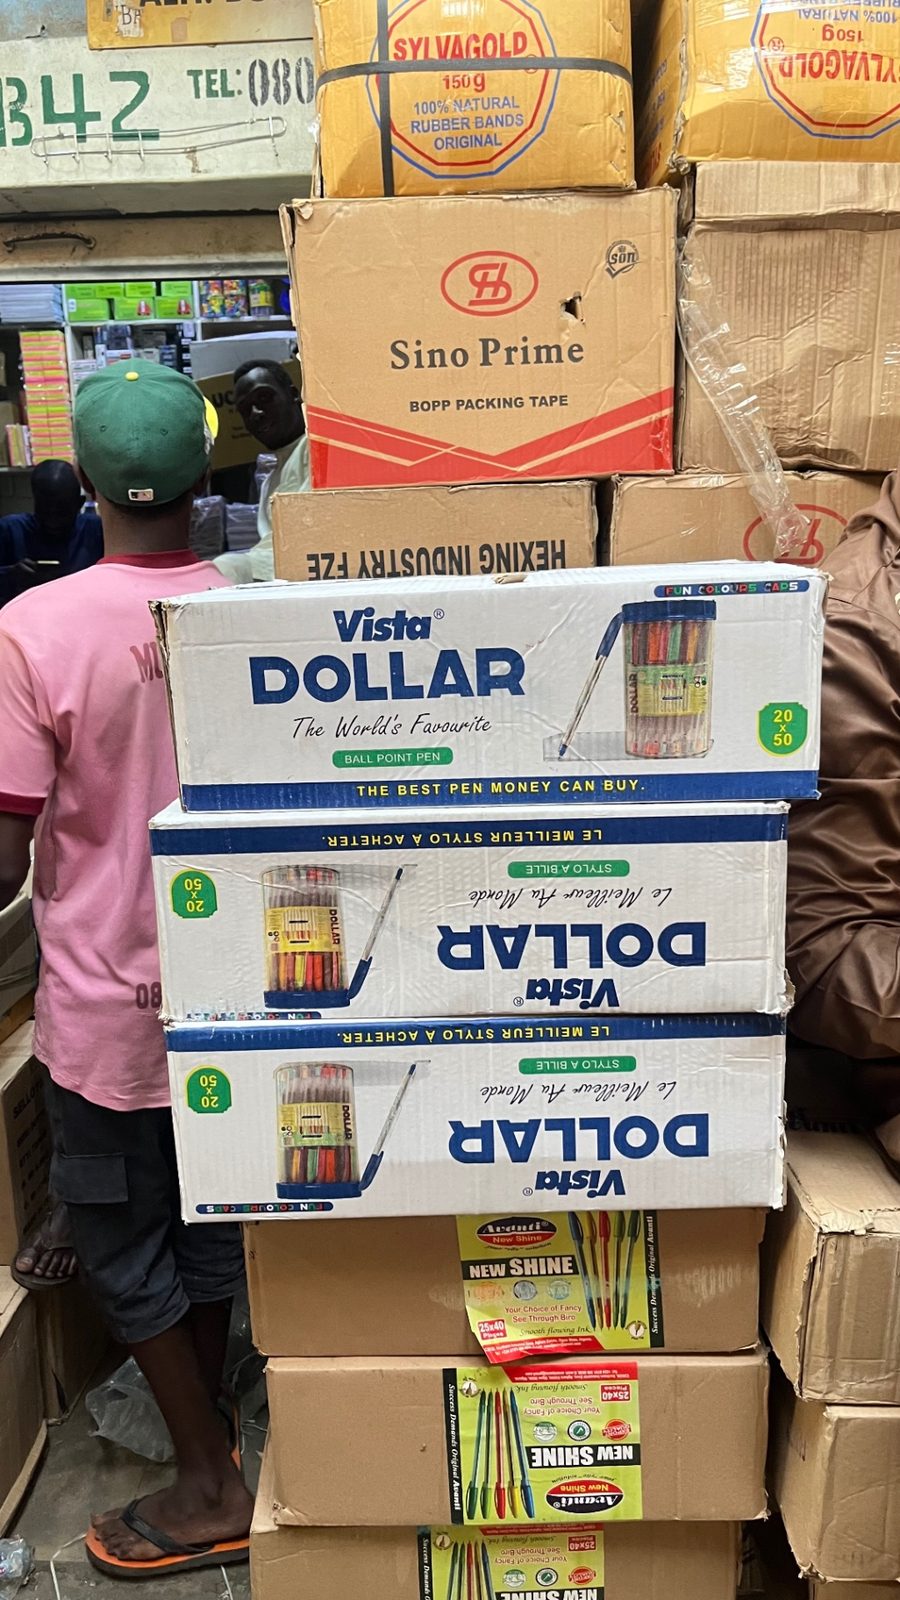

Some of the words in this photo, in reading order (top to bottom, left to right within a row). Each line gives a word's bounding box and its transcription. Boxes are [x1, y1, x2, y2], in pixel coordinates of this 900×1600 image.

[863, 10, 898, 24] 100%
[822, 24, 864, 43] 150g
[393, 32, 527, 60] SYLVAGOLD
[779, 50, 900, 83] YLVAGOLD
[187, 69, 243, 99] TEL:
[443, 73, 485, 92] 150g
[414, 100, 449, 115] 100%
[453, 97, 519, 112] NATURAL
[410, 117, 470, 133] RUBBER
[475, 114, 524, 128] BANDS
[434, 134, 502, 150] ORIGINAL
[390, 340, 469, 370] Sino
[478, 336, 584, 367] Prime
[410, 400, 450, 412] BOPP
[456, 397, 524, 410] PACKING
[532, 395, 568, 407] TAPE
[359, 545, 470, 578] INDUSTRY
[479, 539, 566, 573] HEXING
[307, 552, 348, 581] FZE
[665, 585, 691, 595] FUN
[699, 583, 756, 595] COLOURS
[249, 647, 526, 705] DOLLAR
[630, 673, 639, 713] DOLLAR
[774, 709, 793, 722] 20
[292, 716, 325, 738] The
[335, 714, 402, 737] World's
[410, 713, 492, 735] Favourite
[773, 733, 793, 746] 50
[344, 754, 373, 764] BALL
[377, 753, 412, 763] POINT
[417, 752, 440, 762] PEN
[357, 785, 389, 797] THE
[398, 784, 440, 795] BEST
[451, 783, 482, 794] PEN
[491, 780, 550, 793] MONEY
[559, 780, 595, 791] CAN
[604, 780, 645, 791] BUY.
[321, 834, 403, 847] ACHETER.
[430, 832, 482, 844] STYLO
[491, 830, 574, 843] MEILLEUR
[583, 829, 602, 841] LE
[526, 864, 558, 875] BILLE
[562, 864, 570, 873] A
[574, 863, 612, 874] STYLO
[184, 878, 202, 891] 50
[468, 888, 523, 909] Monde
[531, 888, 557, 909] Au
[563, 886, 643, 908] Meilleur
[652, 887, 673, 907] Le
[187, 900, 204, 912] 20
[329, 909, 340, 945] DOLLAR
[437, 921, 706, 970] DOLLAR
[337, 1030, 418, 1043] ACHETER.
[443, 1028, 494, 1040] STYLO
[502, 1026, 583, 1038] MEILLEUR
[591, 1026, 610, 1037] LE
[536, 1060, 568, 1070] BILLE
[570, 1060, 579, 1069] A
[581, 1059, 620, 1069] STYLO
[200, 1075, 217, 1087] 50
[480, 1083, 533, 1104] Monde
[541, 1083, 567, 1103] Au
[573, 1081, 650, 1102] Meilleur
[657, 1081, 677, 1100] Le
[201, 1096, 219, 1108] 20
[342, 1105, 353, 1140] DOLLAR
[448, 1113, 709, 1164] DOLLAR
[300, 1203, 323, 1211] FUN
[646, 1216, 654, 1243] Avanti
[516, 1234, 542, 1242] Shine
[648, 1244, 656, 1273] Original
[469, 1263, 506, 1278] NEW
[509, 1257, 574, 1275] SHINE
[505, 1306, 521, 1314] Your
[522, 1305, 549, 1314] Choice
[550, 1305, 558, 1313] of
[560, 1304, 582, 1313] Fancy
[512, 1315, 527, 1323] See
[528, 1314, 559, 1324] Through
[651, 1306, 659, 1334] Success
[478, 1321, 505, 1334] 25x40
[519, 1327, 546, 1337] Smooth
[546, 1326, 575, 1336] flowing
[531, 1383, 559, 1393] flowing
[561, 1383, 588, 1392] Smooth
[448, 1383, 456, 1412] Success
[530, 1397, 545, 1405] Biro
[546, 1397, 578, 1406] Through
[602, 1390, 629, 1400] 25x40
[523, 1408, 545, 1416] Fancy
[556, 1407, 582, 1415] Choice
[449, 1413, 458, 1447] Demands
[531, 1446, 594, 1467] SHINE
[597, 1445, 633, 1461] NEW
[450, 1448, 459, 1479] Original
[560, 1484, 586, 1492] Shine
[588, 1483, 609, 1492] New
[452, 1479, 461, 1511] Avanti
[422, 1537, 430, 1564] Success
[516, 1547, 545, 1555] Through
[569, 1541, 595, 1550] 25x40
[494, 1557, 515, 1565] Fancy
[526, 1556, 550, 1564] Choice
[551, 1555, 567, 1563] Your
[423, 1565, 431, 1595] Demands
[563, 1588, 597, 1600] NEW
